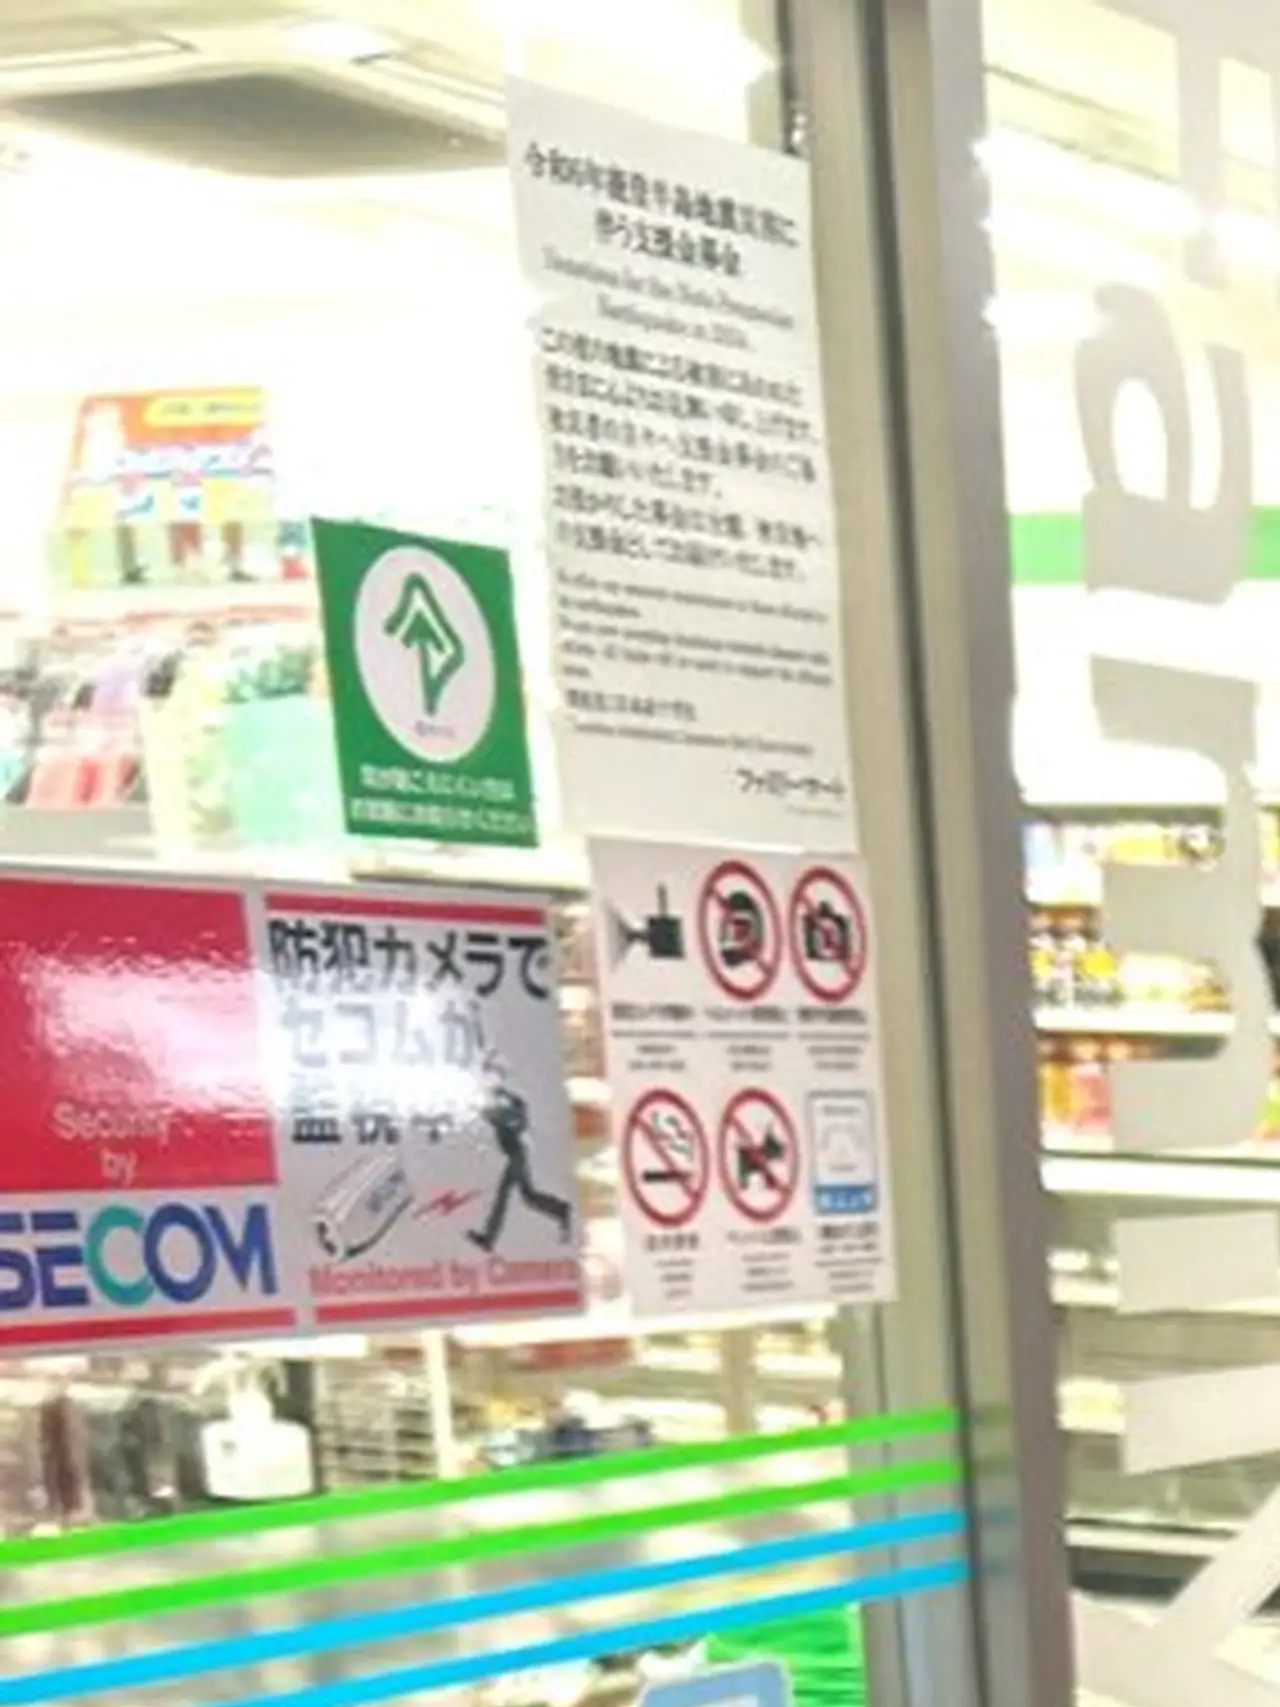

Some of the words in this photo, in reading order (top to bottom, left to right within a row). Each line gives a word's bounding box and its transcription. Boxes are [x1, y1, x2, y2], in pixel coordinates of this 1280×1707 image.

[268, 917, 551, 1000] 防犯カメラで
[100, 1147, 138, 1190] by
